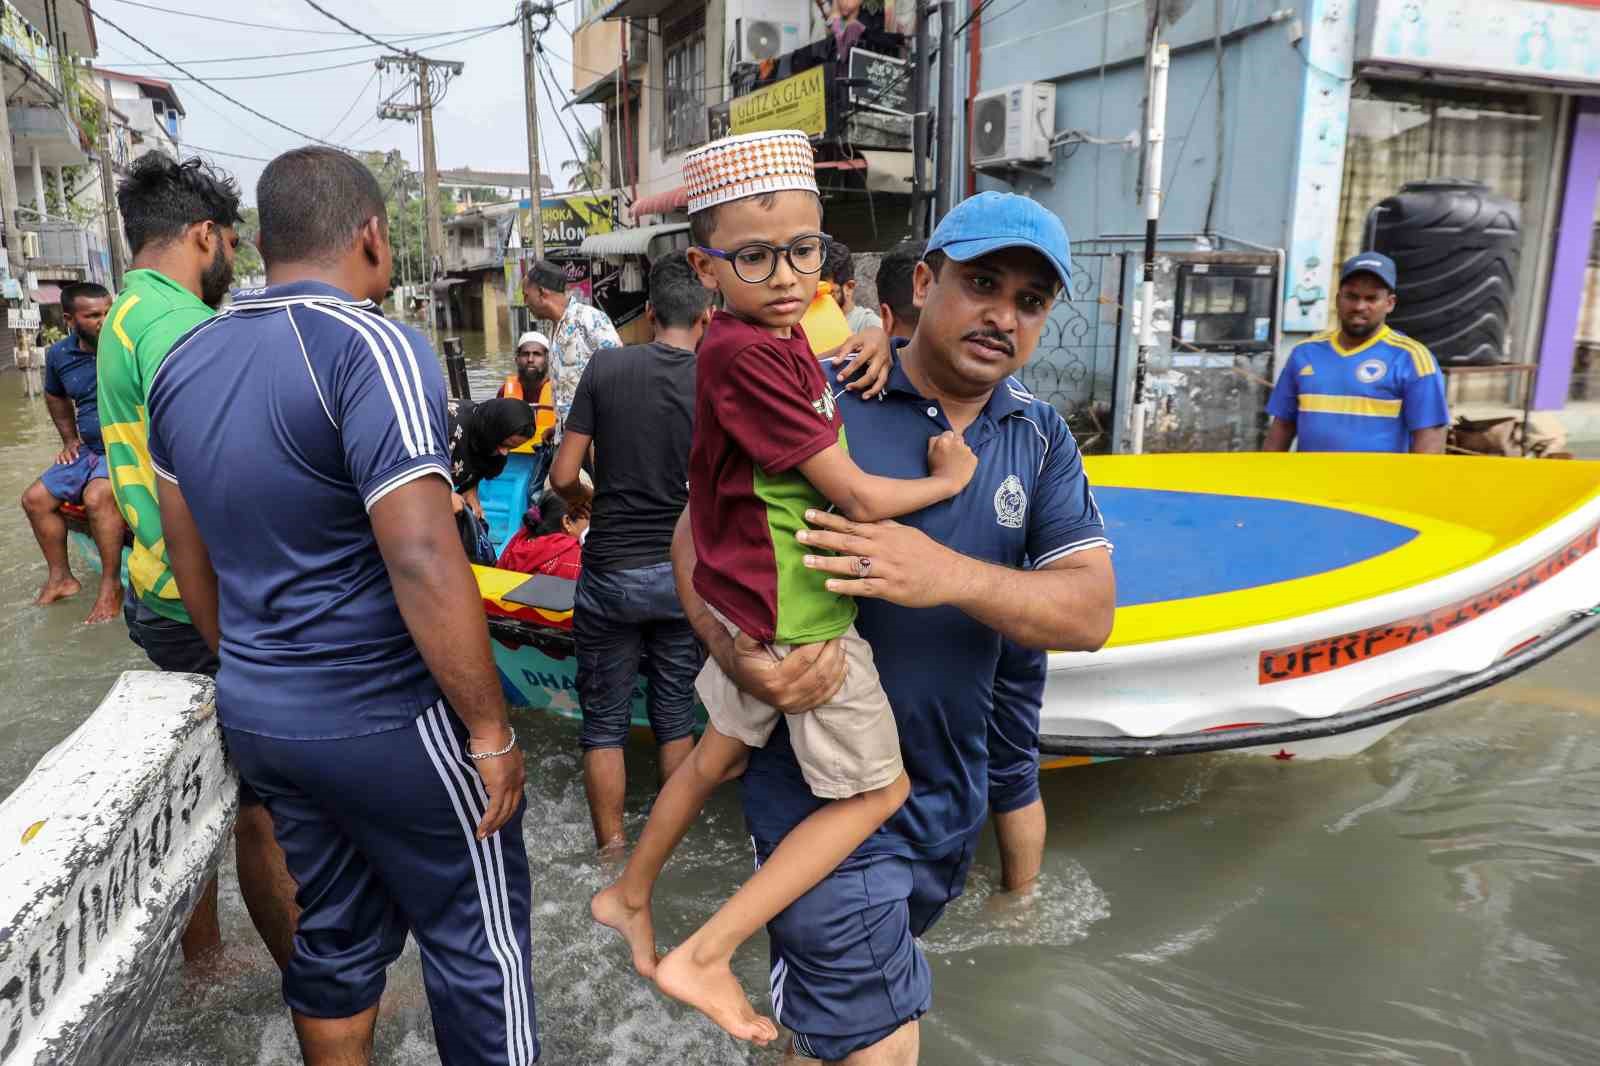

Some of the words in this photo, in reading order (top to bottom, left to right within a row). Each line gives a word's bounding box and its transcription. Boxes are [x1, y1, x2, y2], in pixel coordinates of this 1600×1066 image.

[737, 93, 768, 118] GLITZ
[772, 87, 780, 108] &
[783, 72, 822, 104] GLAM
